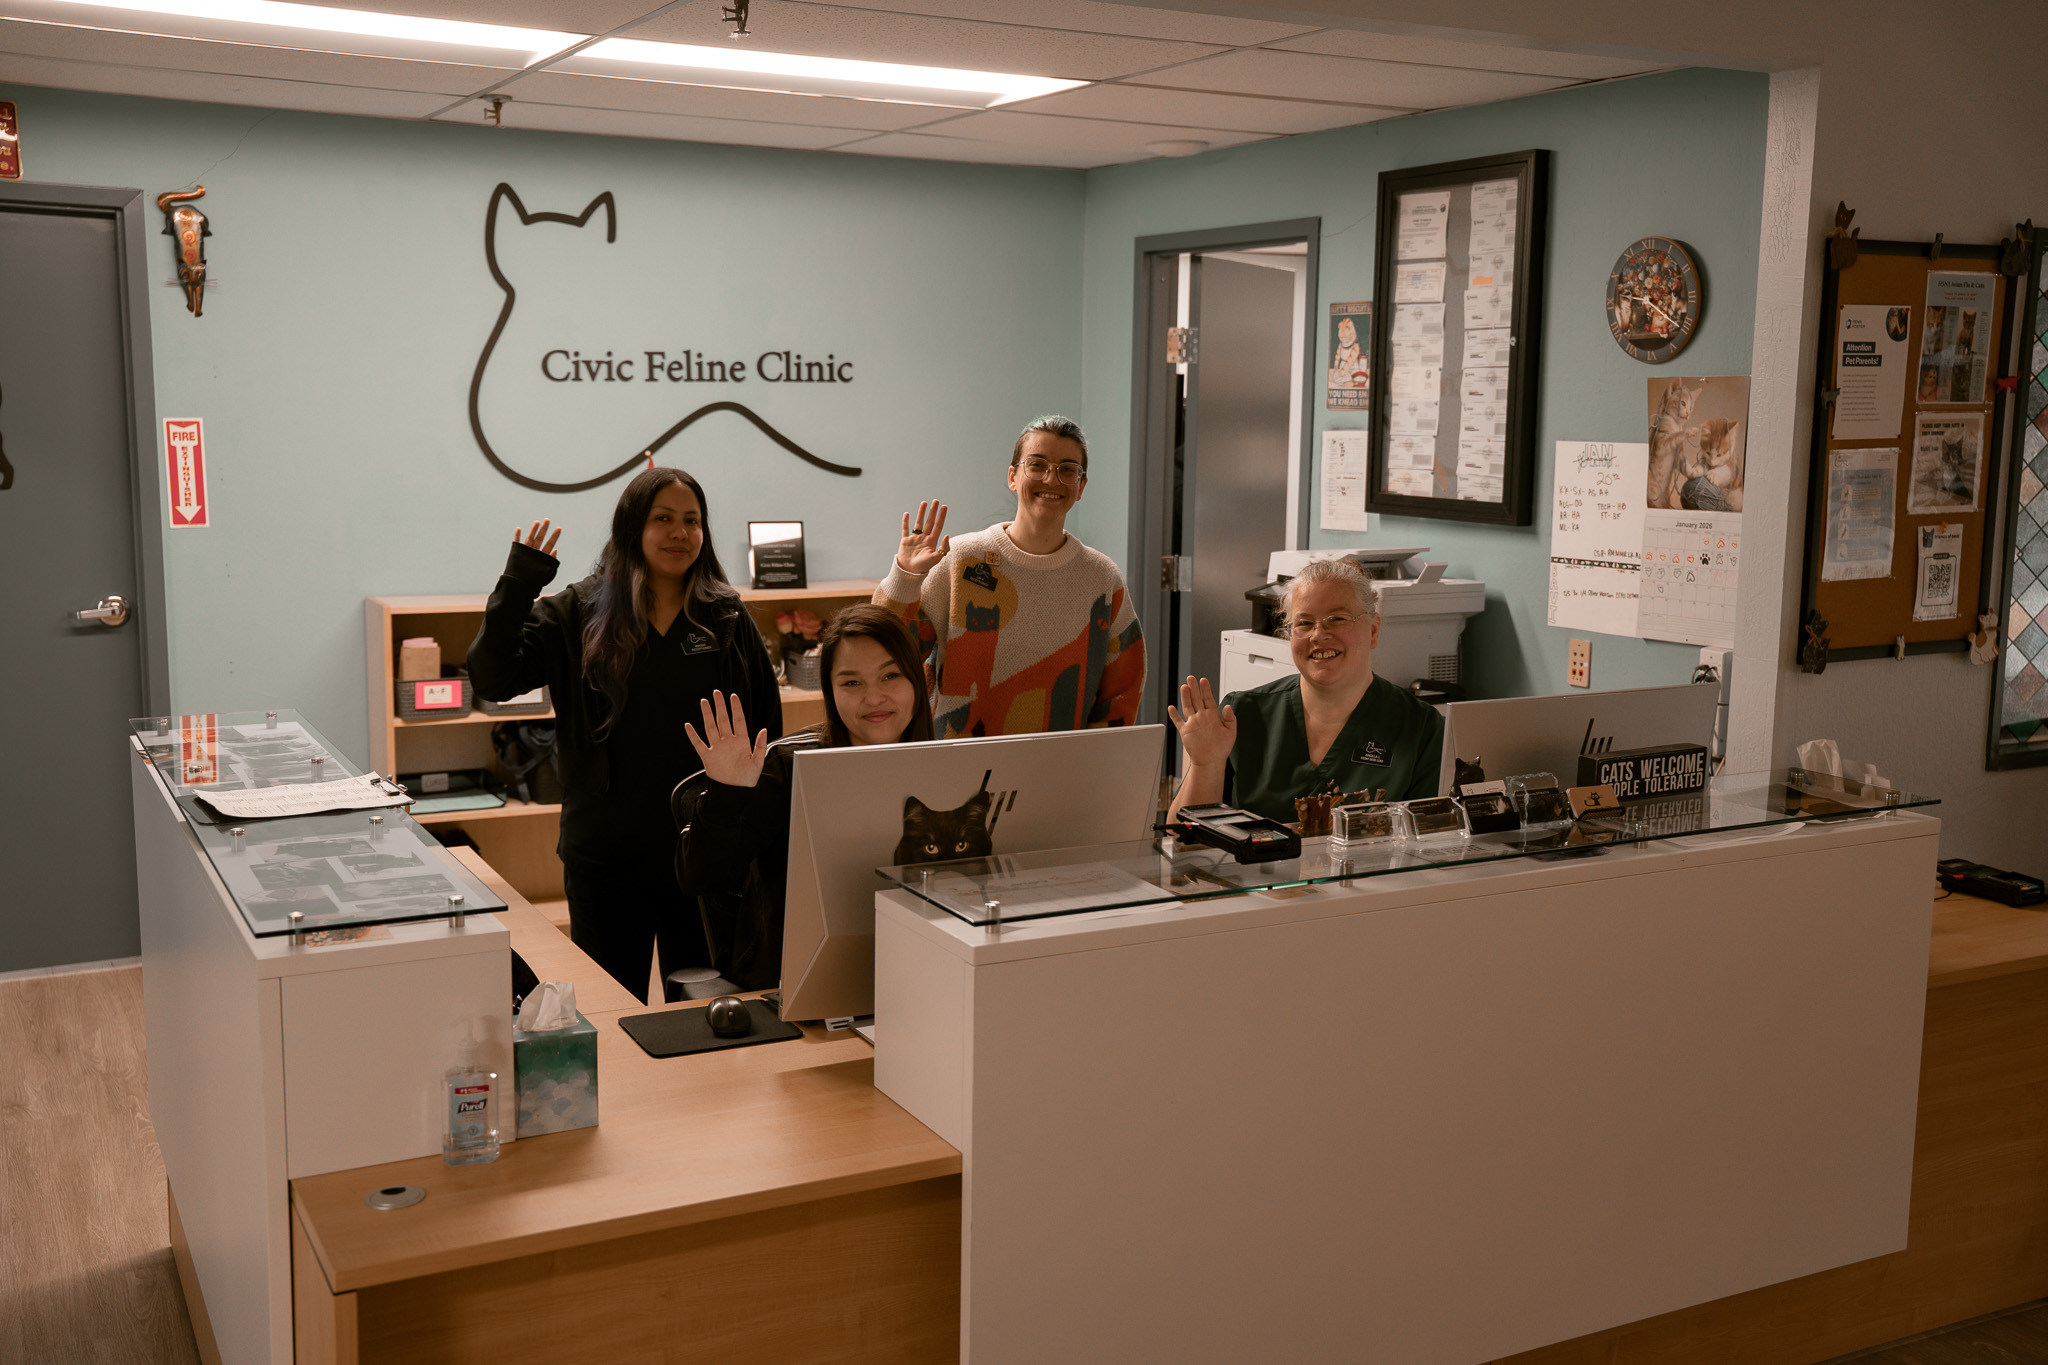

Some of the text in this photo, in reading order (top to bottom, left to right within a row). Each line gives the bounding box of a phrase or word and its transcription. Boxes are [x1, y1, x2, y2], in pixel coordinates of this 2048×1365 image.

[1641, 239, 1655, 250] XII
[1688, 290, 1696, 304] III
[1846, 343, 1872, 351] Attention
[542, 350, 854, 382] Civic Feline Clinic
[1845, 357, 1879, 365] Pet Parents!
[1328, 390, 1341, 398] YOU
[1342, 390, 1357, 398] NEED
[172, 432, 195, 441] FIRE
[1585, 443, 1614, 468] JAN
[181, 446, 191, 507] EXTINGUISHER
[1675, 521, 1713, 530] January 2026
[1600, 752, 1705, 784] CATS WELCOME
[1644, 771, 1703, 794] TOLERATED
